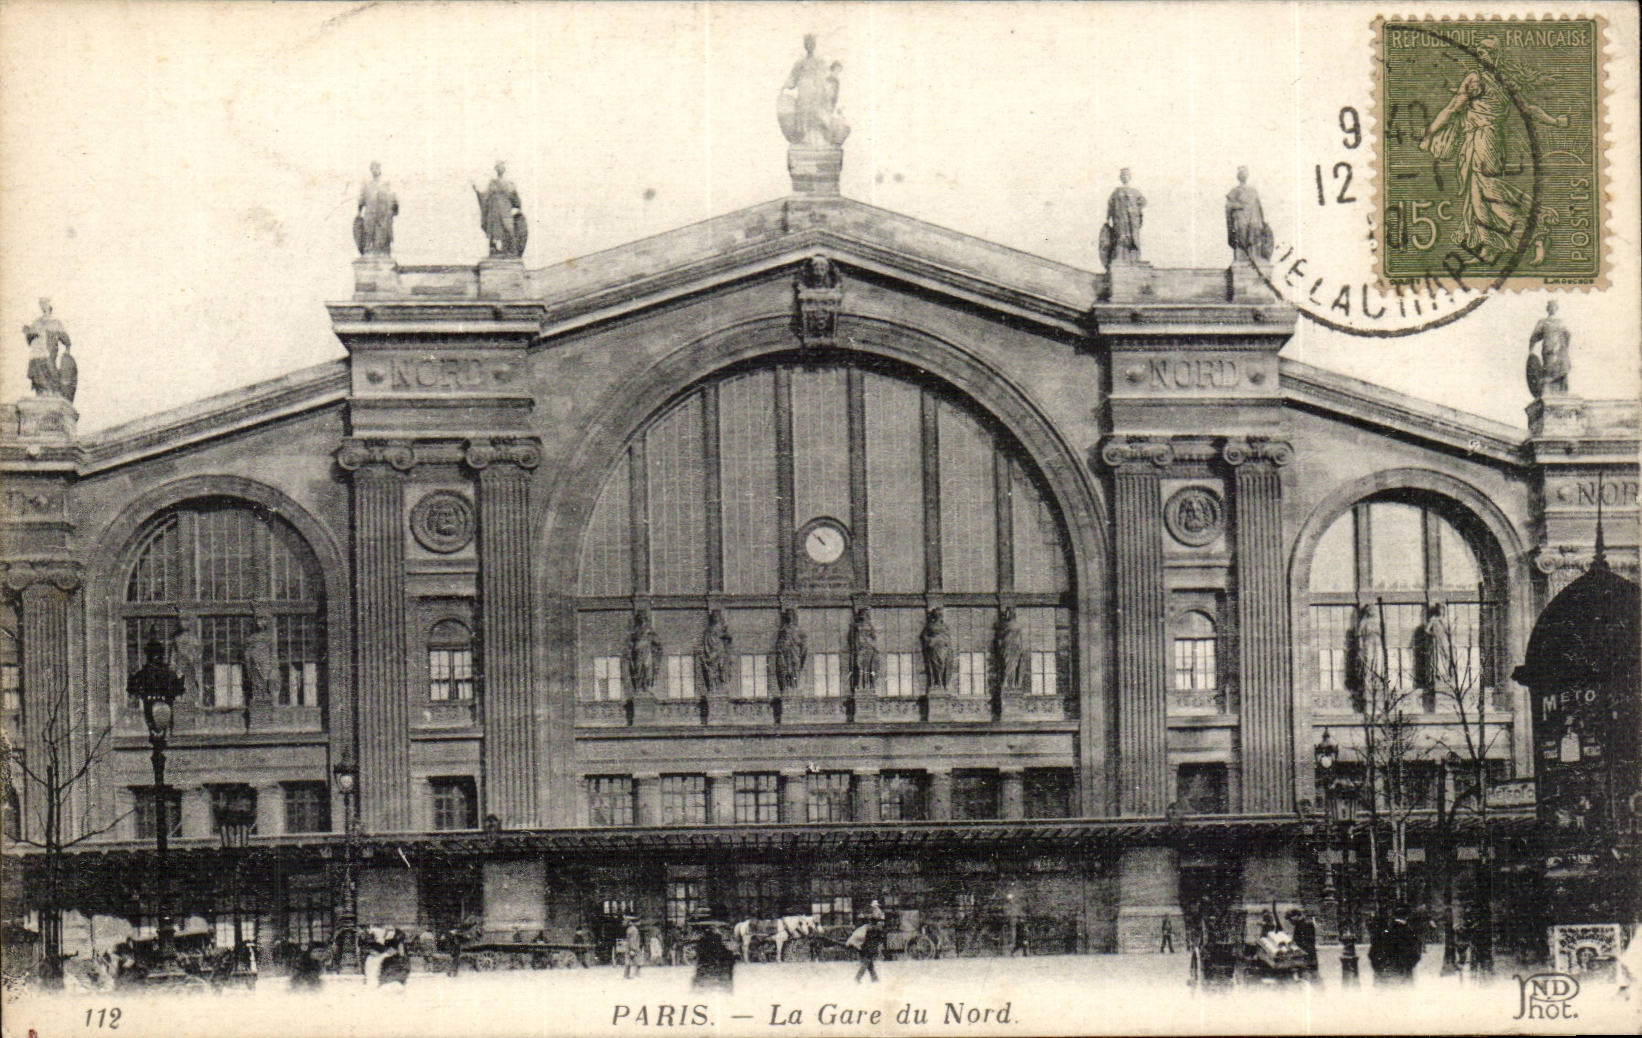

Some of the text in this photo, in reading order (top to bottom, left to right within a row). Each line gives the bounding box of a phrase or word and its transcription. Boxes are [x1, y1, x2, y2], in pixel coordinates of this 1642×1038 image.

[1339, 106, 1361, 149] 9
[1316, 162, 1356, 206] 12
[1570, 178, 1589, 262] POSTES
[1149, 358, 1240, 389] NORD
